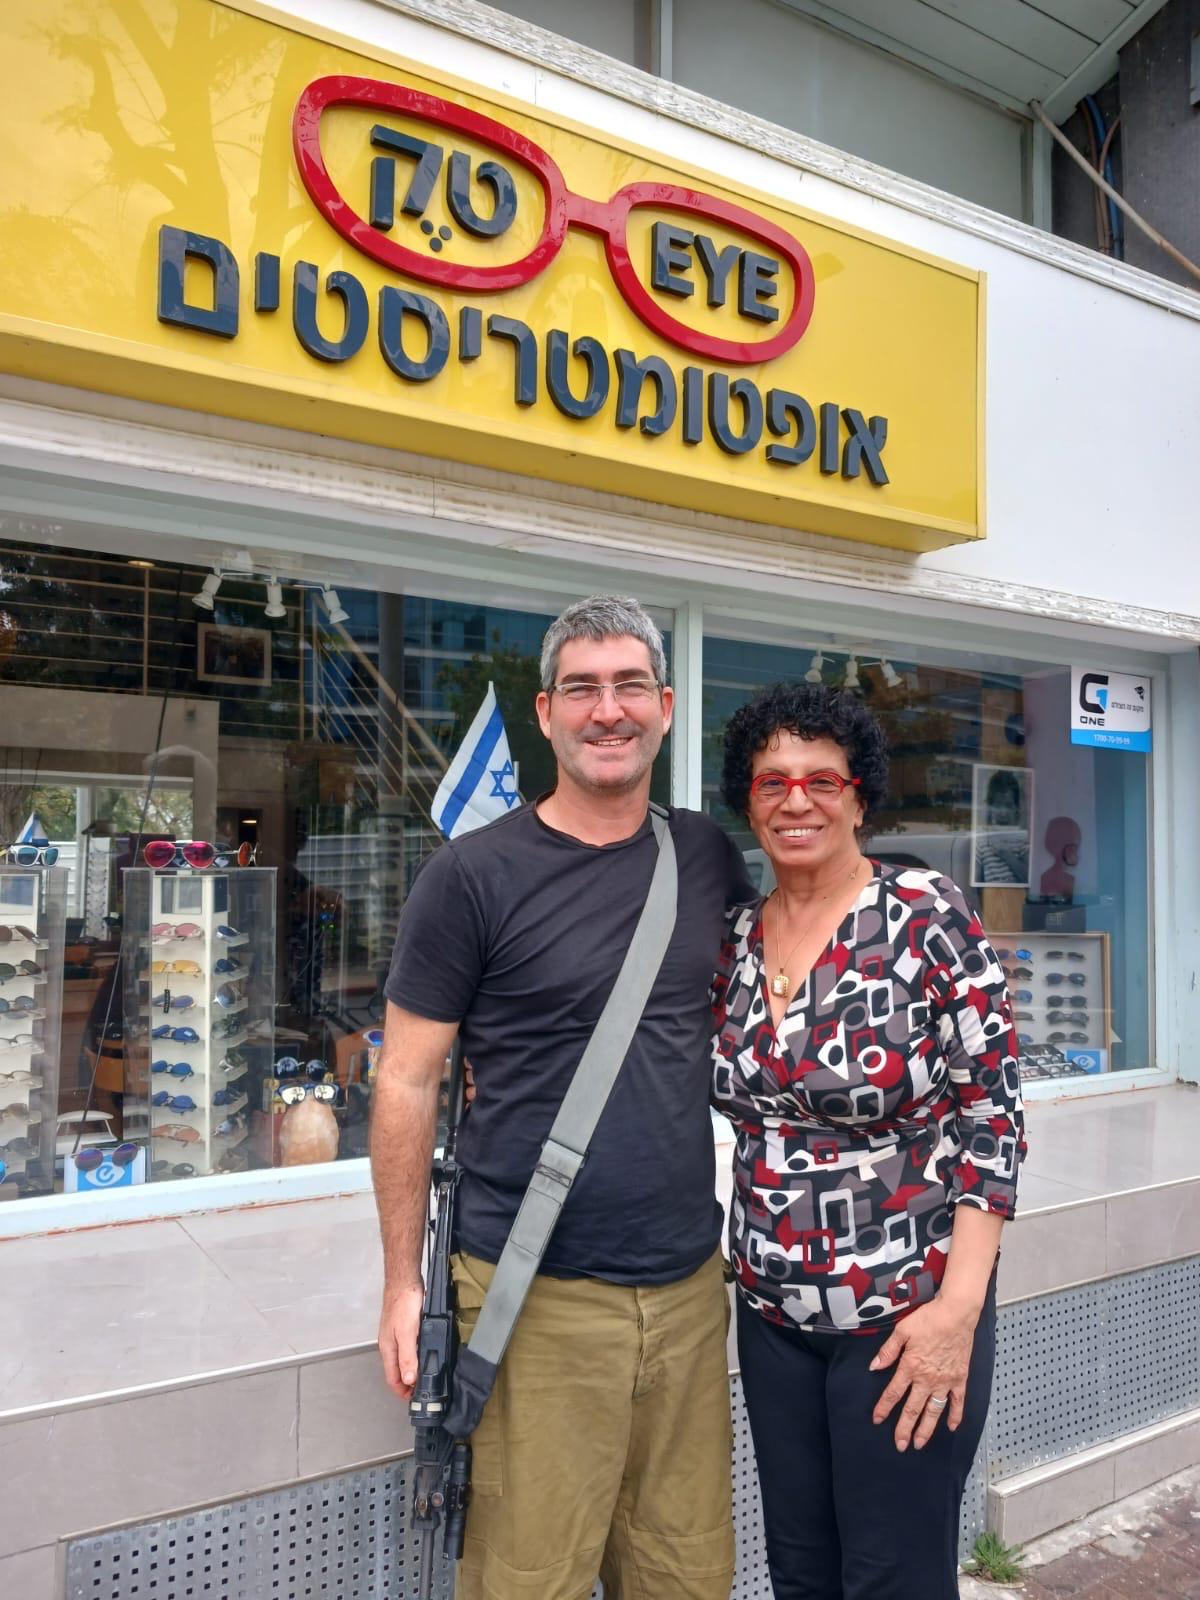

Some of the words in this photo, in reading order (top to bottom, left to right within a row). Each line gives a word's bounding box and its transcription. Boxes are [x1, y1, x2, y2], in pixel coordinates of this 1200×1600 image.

[651, 220, 780, 323] EYE
[157, 224, 889, 486] אופטומטריסטים
[1080, 716, 1105, 726] ONE
